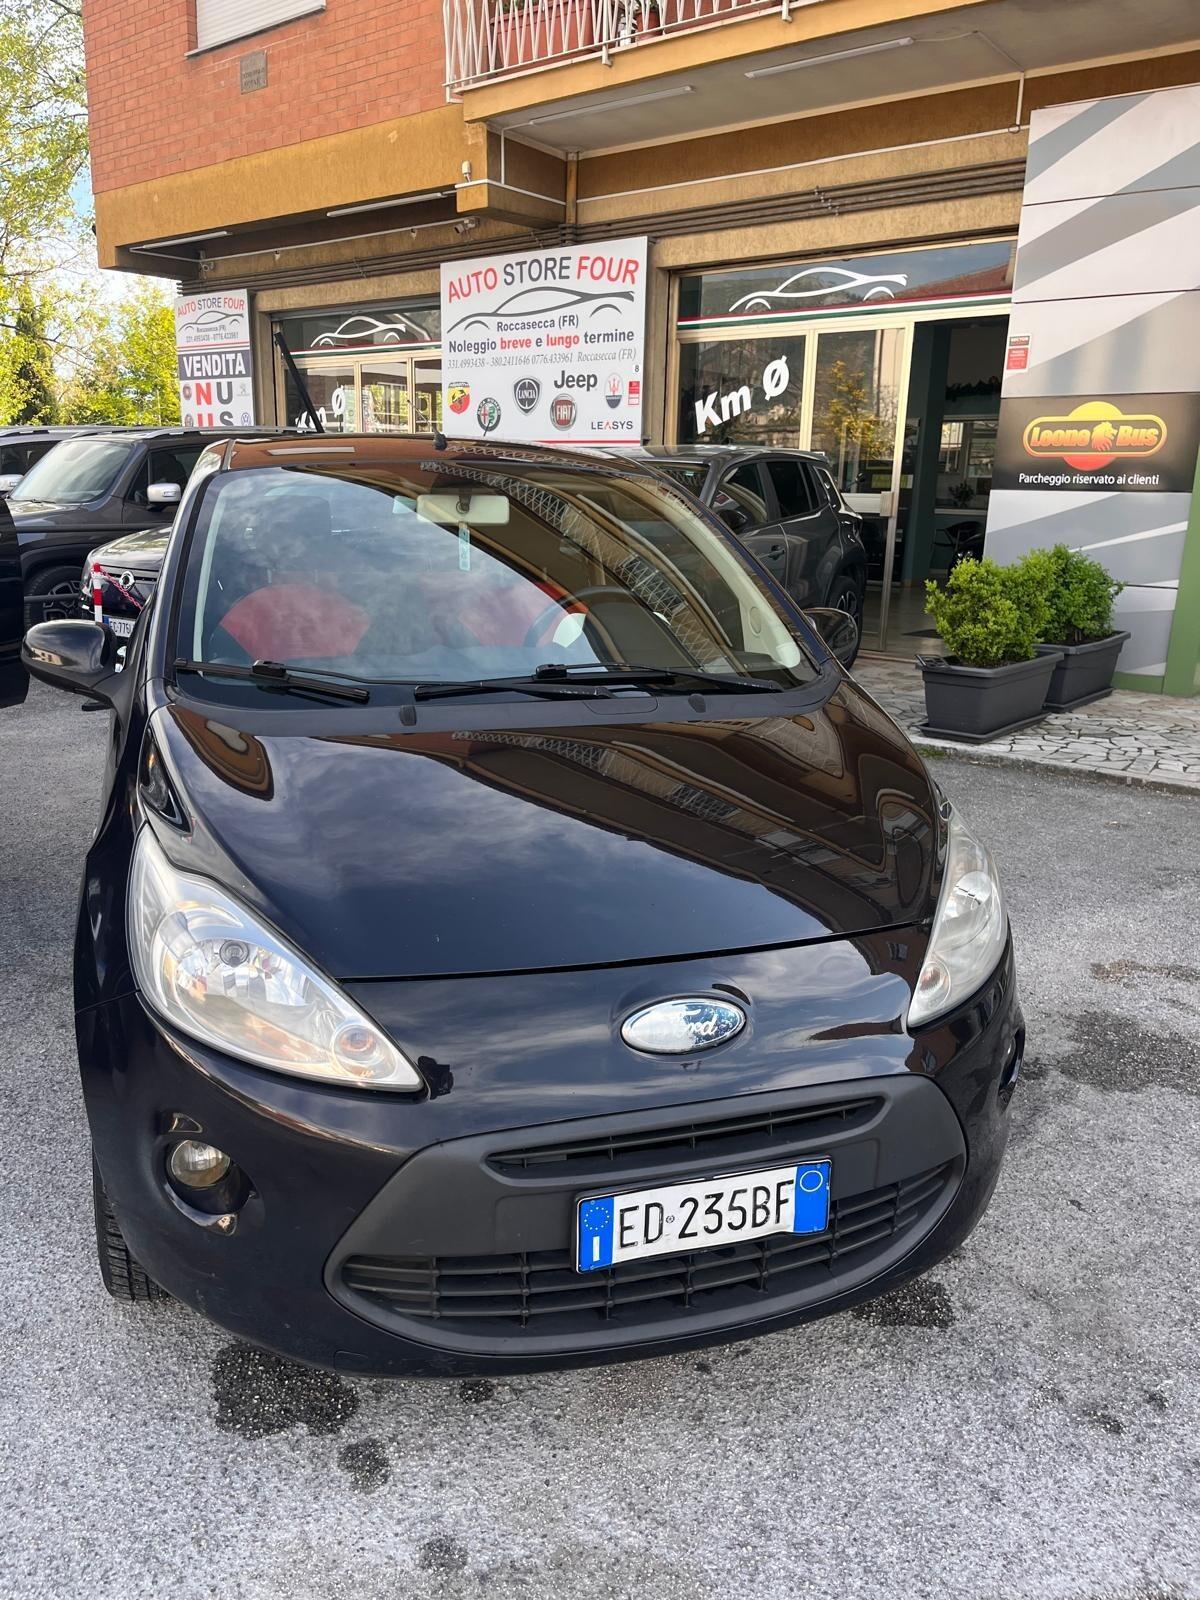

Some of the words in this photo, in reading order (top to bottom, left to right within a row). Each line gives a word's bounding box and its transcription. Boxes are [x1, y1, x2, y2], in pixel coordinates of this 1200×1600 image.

[448, 267, 498, 303] AUTO
[503, 256, 572, 286] STORE
[576, 256, 639, 285] FOUR
[177, 301, 197, 318] AUTO
[197, 297, 222, 310] STORE
[223, 297, 245, 310] FOUR
[496, 319, 555, 332] Roccasecca
[558, 314, 579, 330] (FR)
[449, 338, 497, 355] Noleggio
[500, 337, 532, 350] breve
[535, 337, 543, 347] e
[546, 333, 580, 349] lungo
[584, 329, 635, 344] termine
[183, 353, 246, 378] VENDITA
[448, 357, 485, 369] 331.4993438
[577, 351, 616, 362] Roccasecca
[618, 347, 636, 361] (FR)
[634, 364, 640, 373] 8
[553, 370, 598, 392] Jeep
[518, 389, 536, 399] LANCIA
[556, 404, 572, 420] FIAT
[695, 385, 752, 435] Km
[591, 420, 634, 430] LEASYS
[1030, 426, 1091, 447] Leone
[1115, 425, 1159, 447] Bus
[1018, 473, 1071, 486] Parcheggio
[1072, 474, 1115, 485] riservato
[1116, 474, 1127, 485] ai
[1127, 474, 1160, 485] clienti
